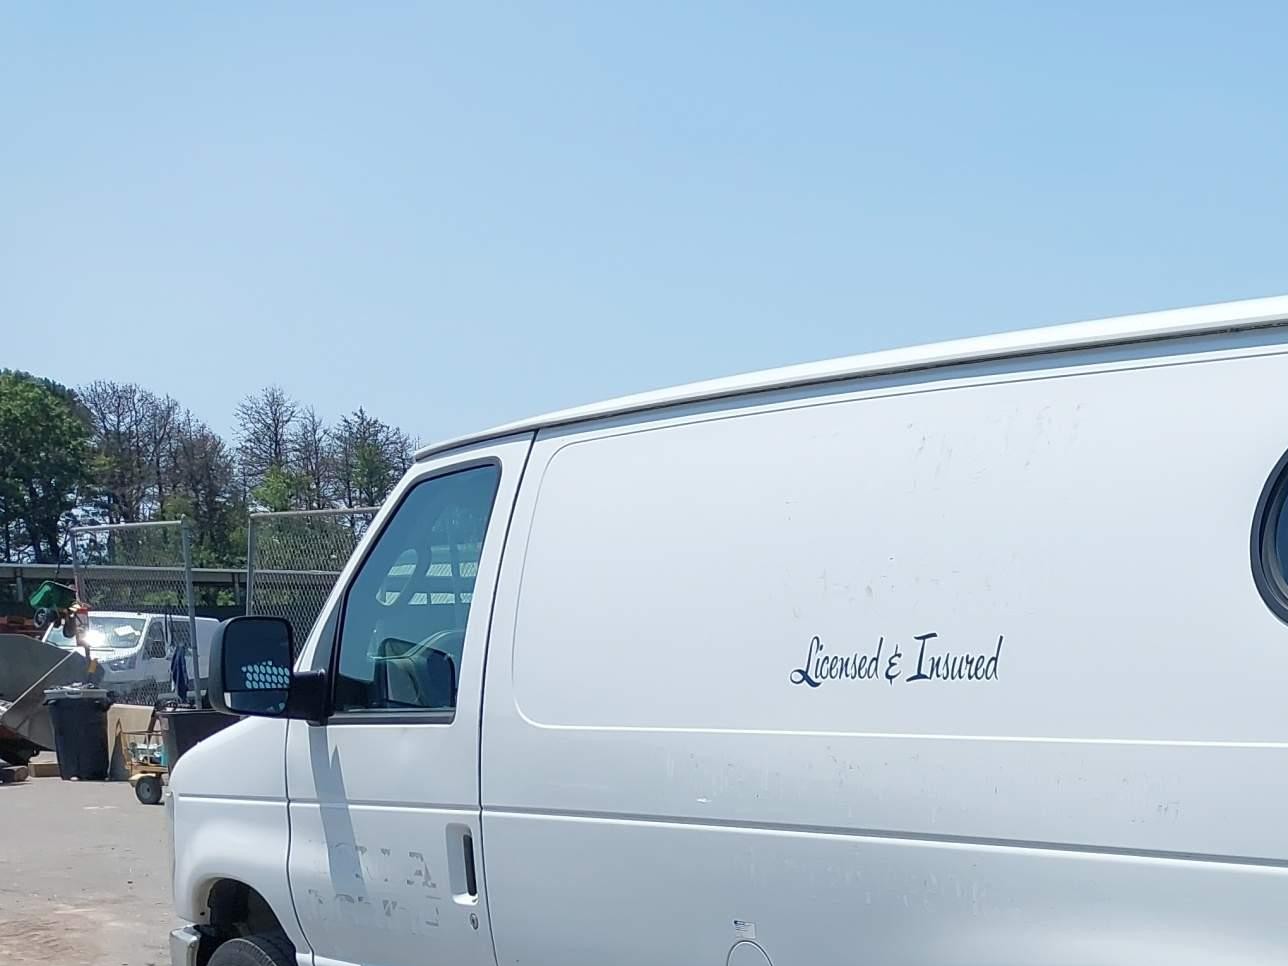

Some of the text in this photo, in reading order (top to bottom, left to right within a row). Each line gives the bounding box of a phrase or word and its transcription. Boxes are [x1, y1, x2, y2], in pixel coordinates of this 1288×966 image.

[790, 632, 1004, 688] Licensed & Insured
